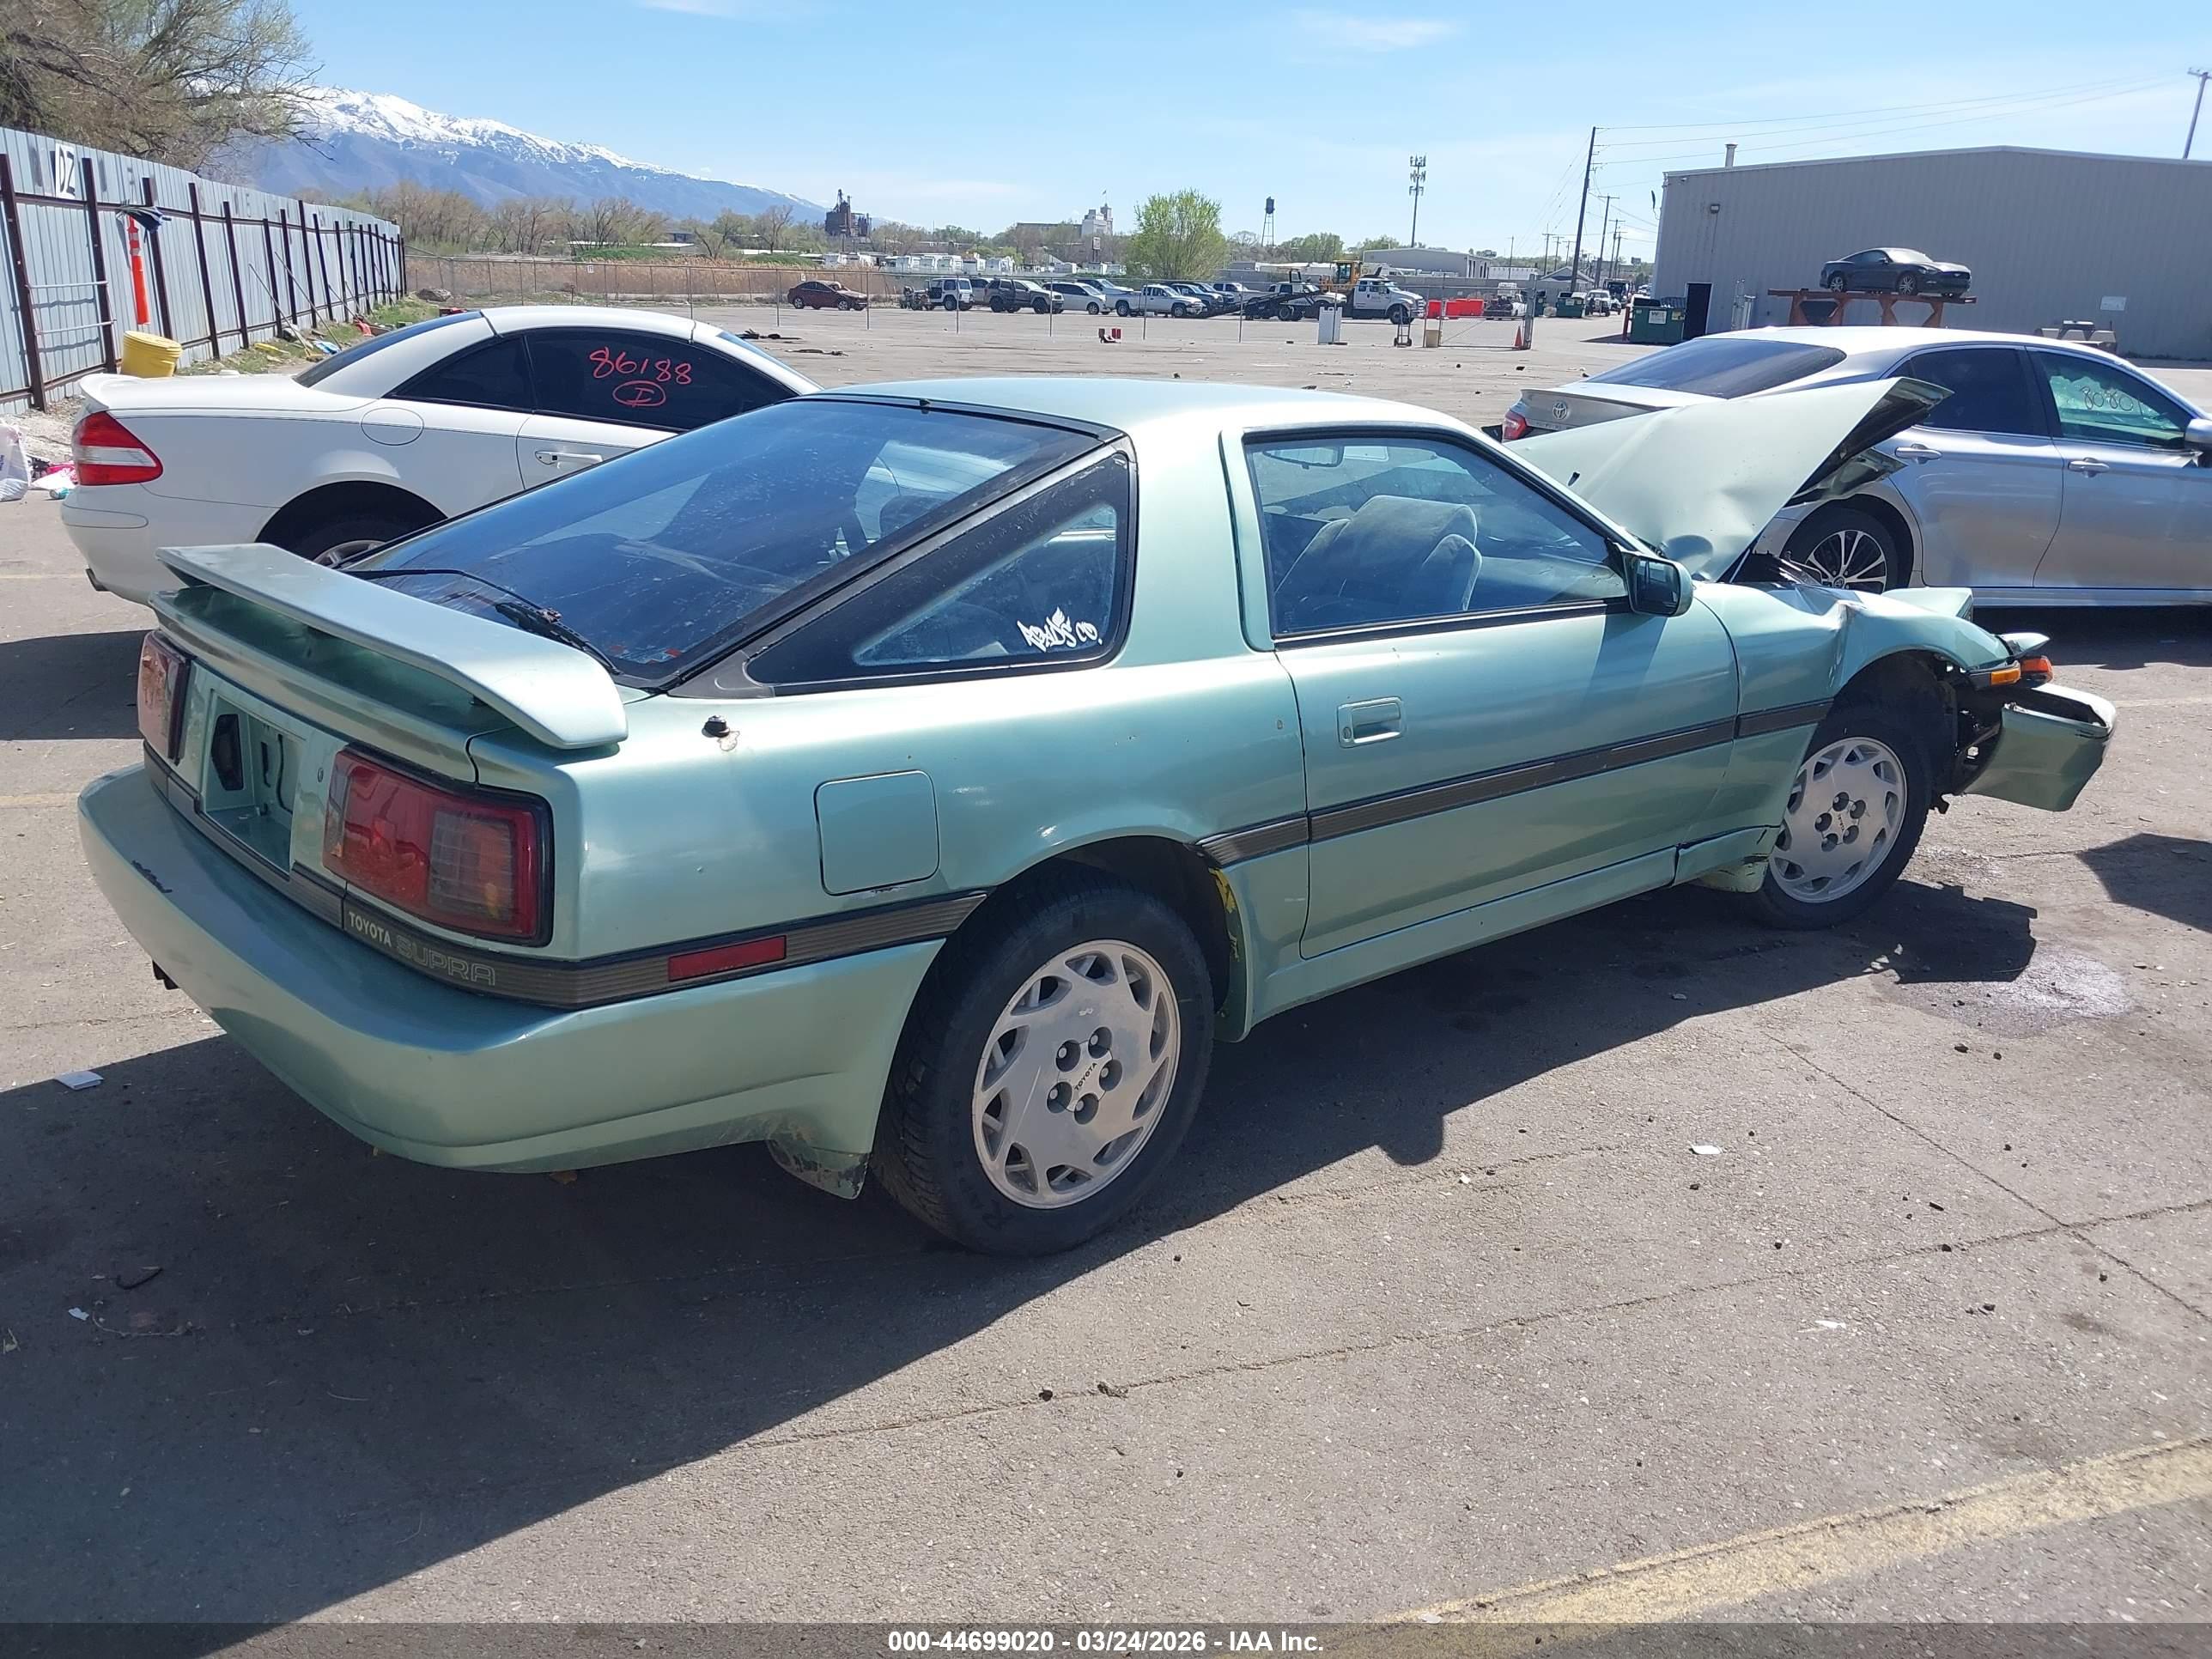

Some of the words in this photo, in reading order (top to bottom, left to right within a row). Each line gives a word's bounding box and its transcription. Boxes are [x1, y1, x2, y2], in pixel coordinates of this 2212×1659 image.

[589, 346, 692, 385] 86188
[349, 911, 392, 947] TOYOTA
[396, 934, 495, 986] SUPRA
[1074, 1062, 1097, 1091] TOYOTA
